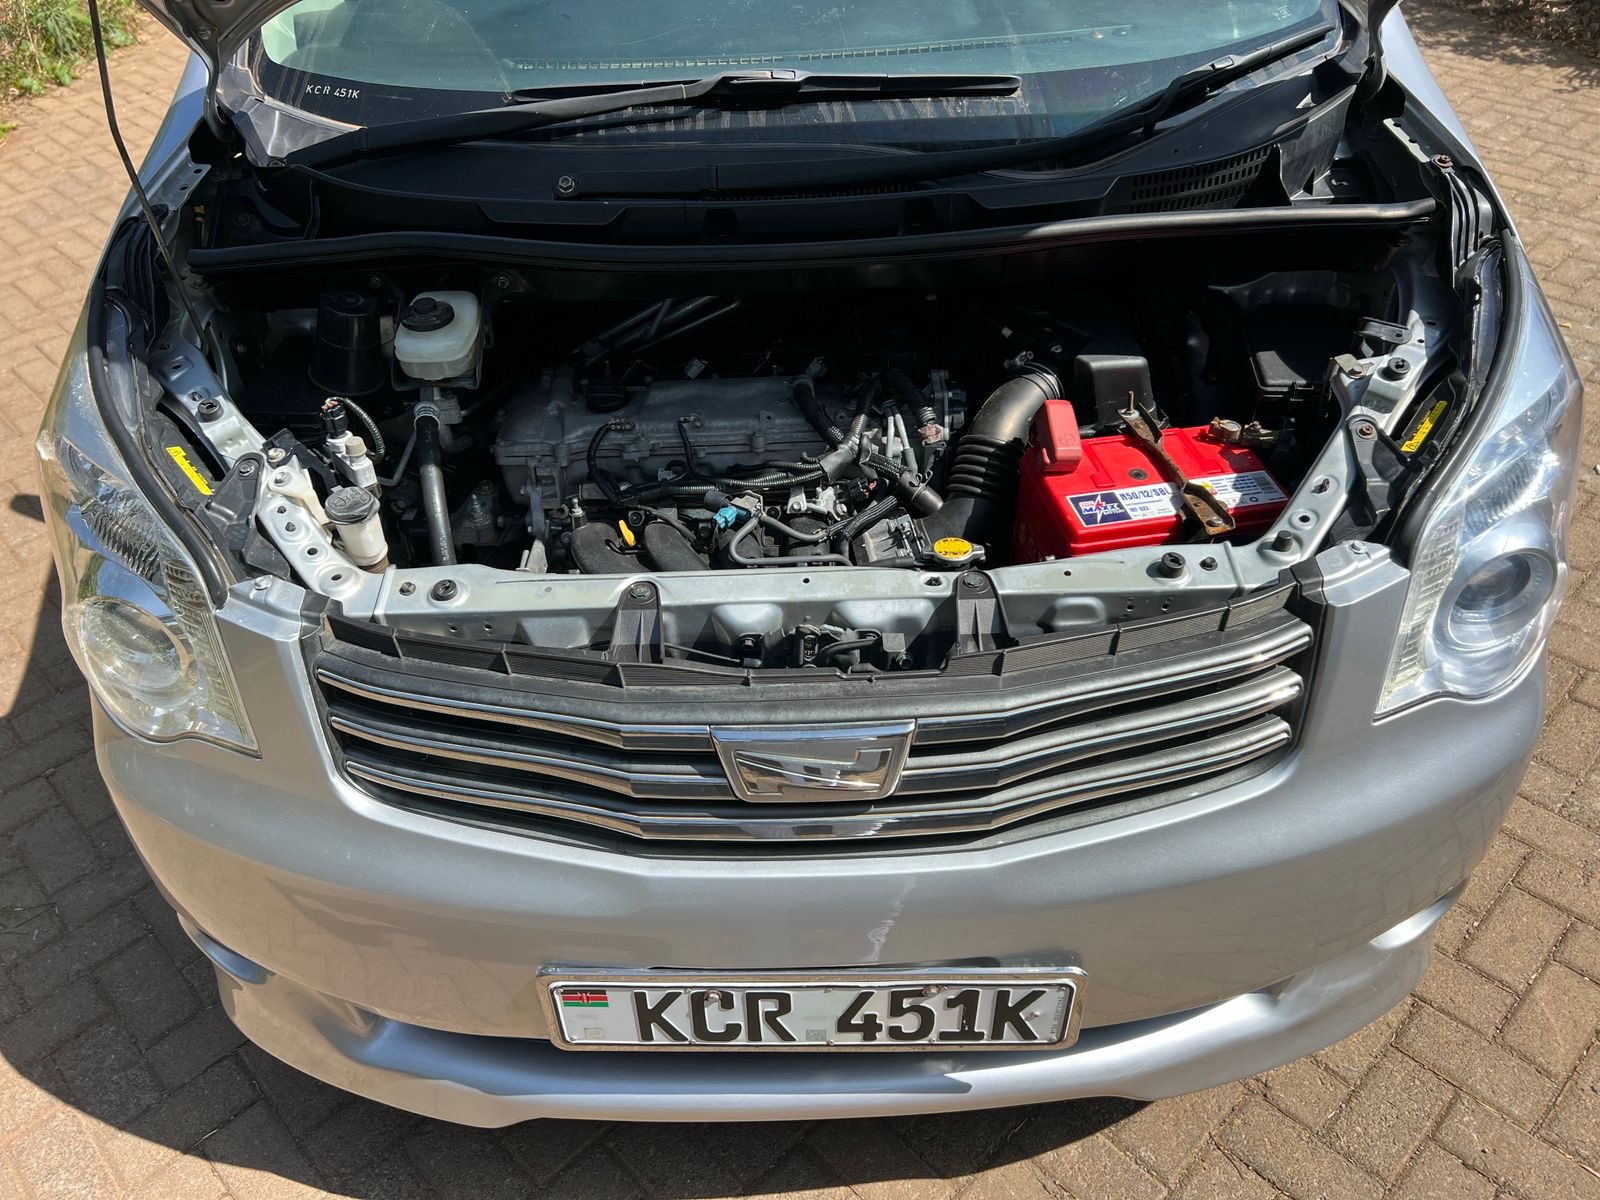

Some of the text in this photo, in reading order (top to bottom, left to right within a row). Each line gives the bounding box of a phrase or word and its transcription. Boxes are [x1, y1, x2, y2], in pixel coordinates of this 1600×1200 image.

[334, 88, 360, 99] 451K
[632, 989, 797, 1043] KCR
[836, 988, 1048, 1042] 451K
